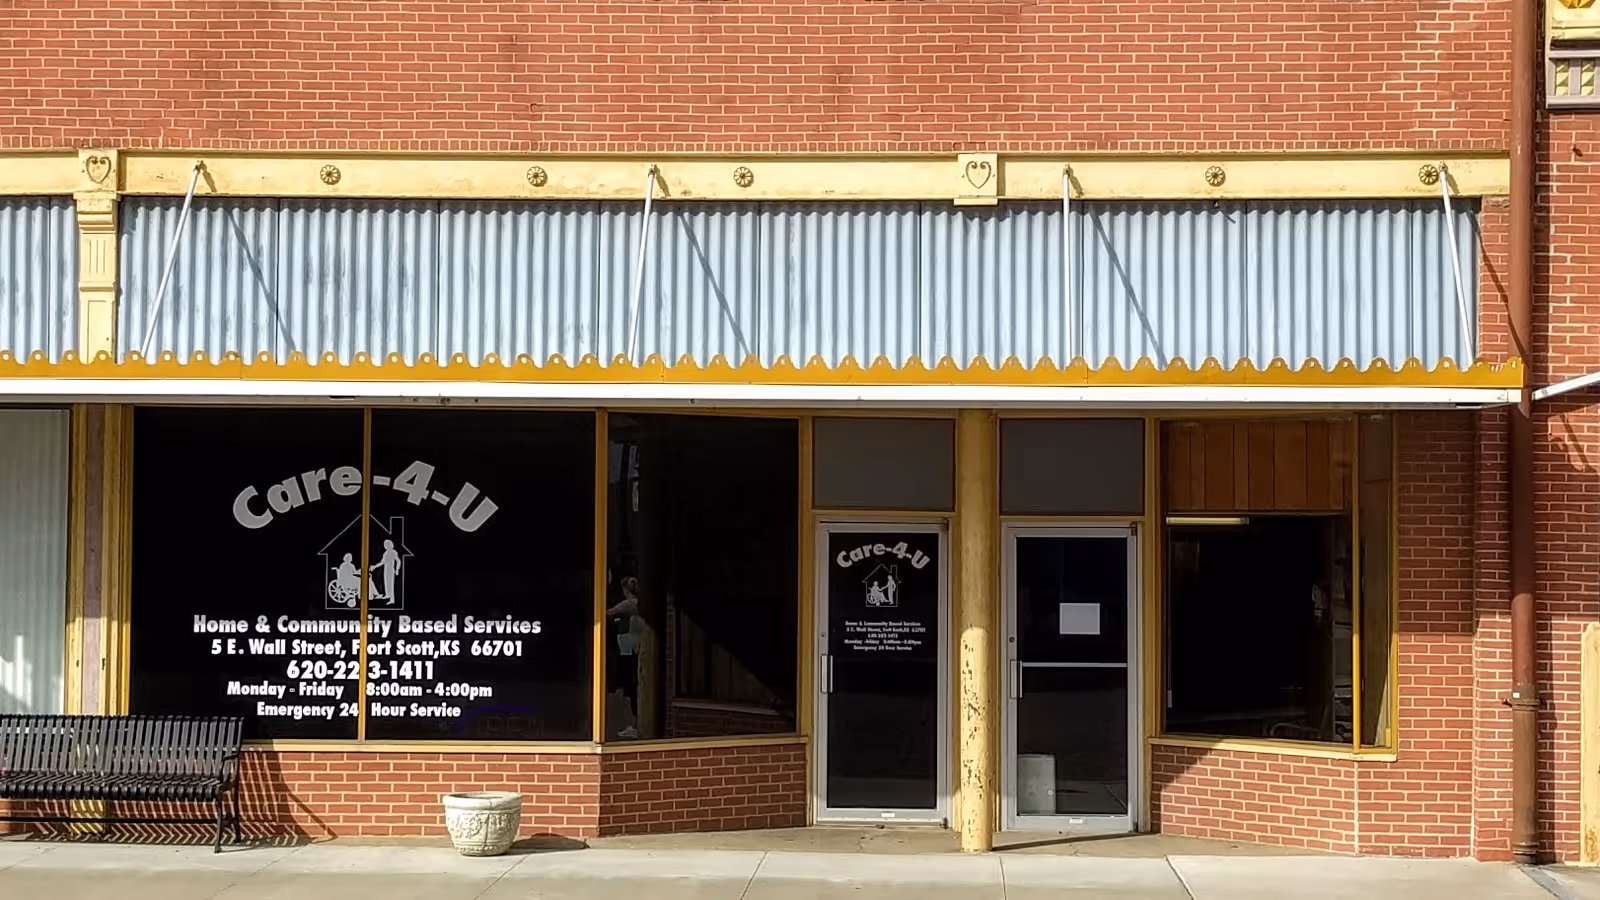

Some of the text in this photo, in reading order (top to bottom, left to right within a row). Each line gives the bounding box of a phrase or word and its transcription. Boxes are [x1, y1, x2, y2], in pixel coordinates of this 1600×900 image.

[233, 460, 498, 532] Care-4-U
[836, 541, 931, 569] Care-4-U
[193, 614, 542, 638] Home & Community Based Services
[211, 638, 222, 655] 5
[227, 638, 245, 655] E.
[248, 638, 286, 655] Wall
[291, 639, 347, 658] Street,
[351, 639, 392, 656] Fort
[470, 640, 523, 657] 66701
[286, 660, 434, 680] 620-223-1411
[227, 680, 286, 699] Monday
[299, 681, 344, 699] Friday
[366, 682, 423, 697] 8:00am
[434, 682, 493, 700] 4:00pm
[257, 701, 462, 720] Emergency 24 Hour Service
